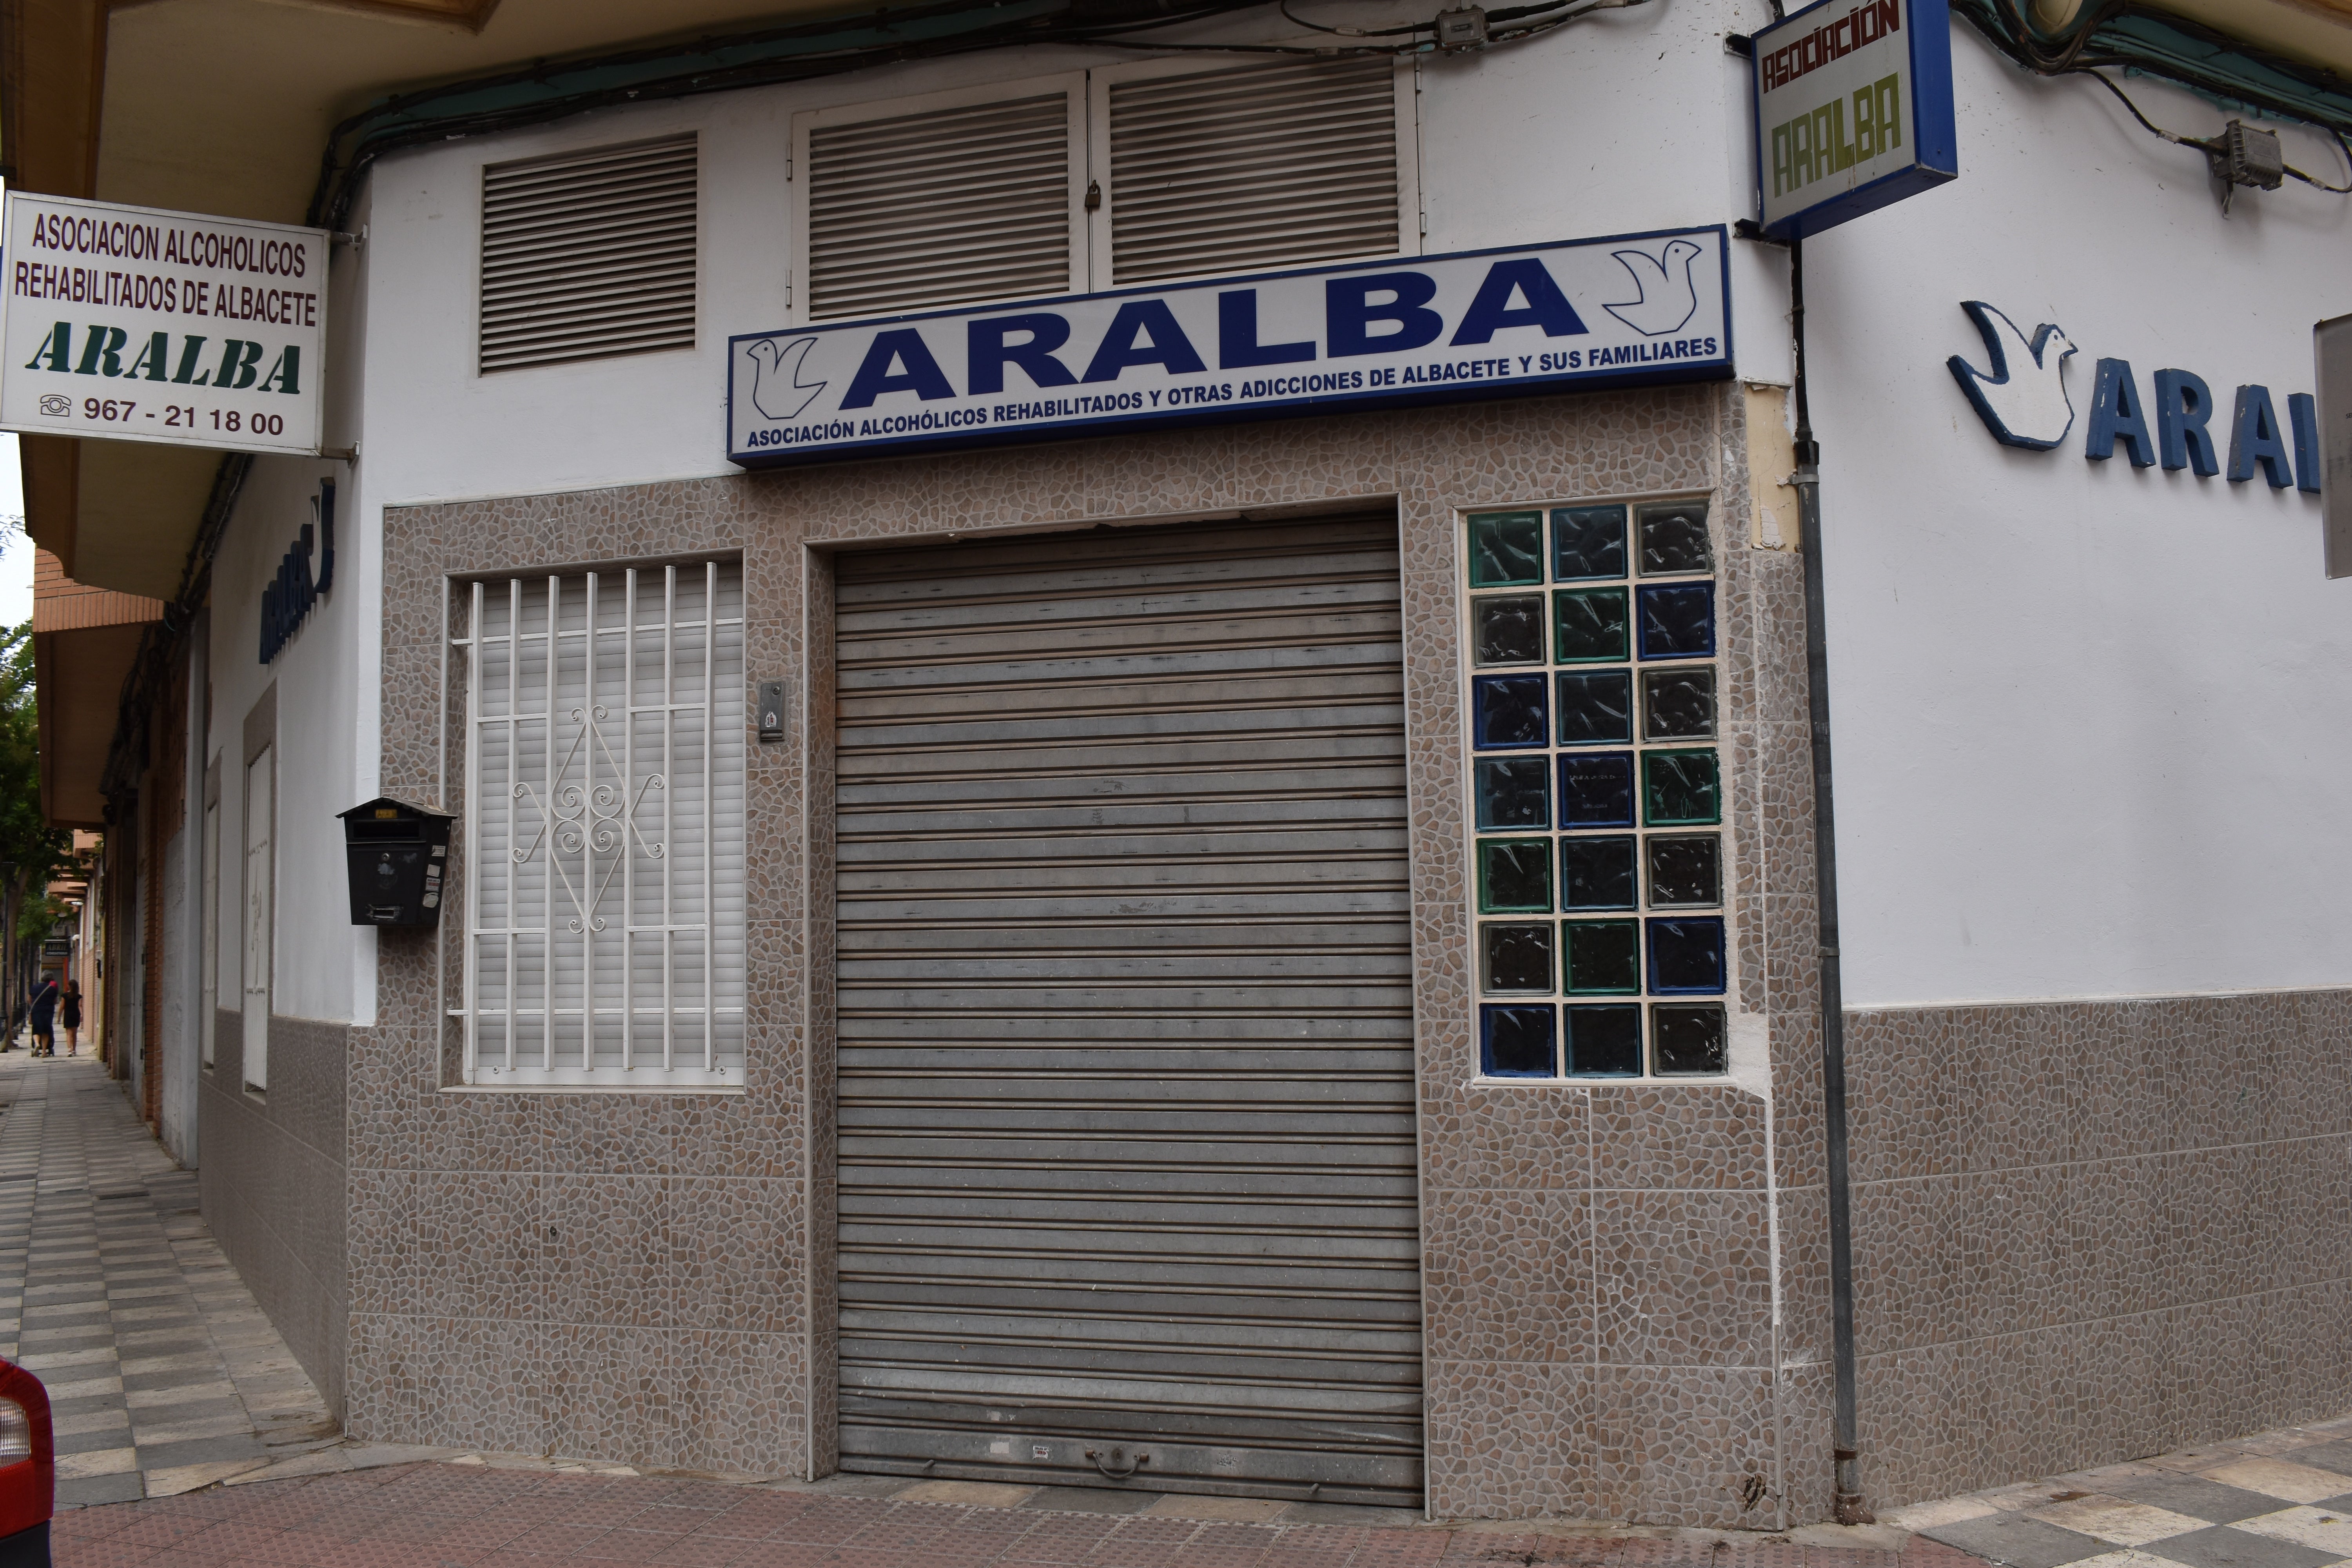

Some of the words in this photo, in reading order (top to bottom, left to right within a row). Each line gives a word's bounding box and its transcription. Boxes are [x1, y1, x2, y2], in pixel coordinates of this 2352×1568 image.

[1762, 0, 1899, 94] ASOCIACIÓN
[1772, 72, 1901, 198] ARALBA
[33, 214, 159, 261] ASOCIACION
[165, 229, 305, 278] ALCOHOLICOS
[15, 261, 176, 312] REHABILITADOS
[183, 280, 209, 316] DE
[214, 284, 316, 327] ALBACETE
[838, 258, 1589, 410] ARALBA
[25, 321, 300, 394] ARALBA
[748, 419, 854, 447] ASOCIACIÓN
[860, 408, 987, 436] ALCOHÓLICOS
[994, 392, 1142, 422] REHABILITADOS
[1149, 390, 1161, 407] Y
[1168, 384, 1232, 405] OTRAS
[1240, 371, 1362, 398] ADICCIONES
[1370, 368, 1395, 386] DE
[1402, 359, 1510, 383] ALBACETE
[1518, 356, 1532, 373] Y
[1540, 351, 1581, 371] SUS
[1589, 338, 1717, 366] FAMILIARES
[85, 398, 136, 421] 967
[165, 405, 194, 427] 21
[210, 410, 240, 432] 18
[251, 414, 283, 435] 00
